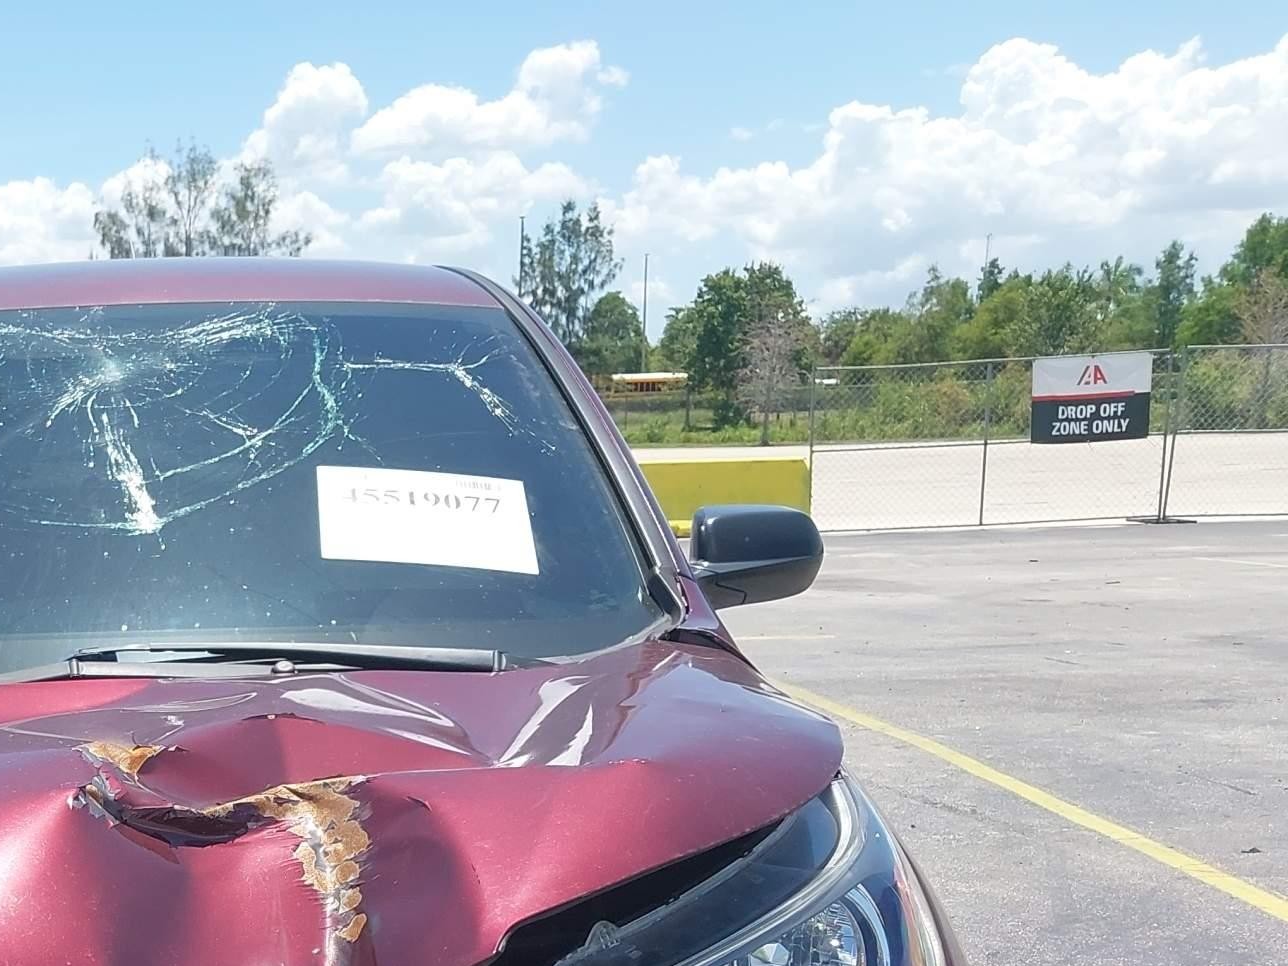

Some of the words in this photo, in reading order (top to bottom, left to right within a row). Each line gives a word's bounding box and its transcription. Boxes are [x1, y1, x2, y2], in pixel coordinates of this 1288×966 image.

[1058, 404, 1096, 419] DROP
[1099, 402, 1126, 417] OFF
[1051, 421, 1089, 436] ZONE
[1092, 418, 1130, 434] ONLY
